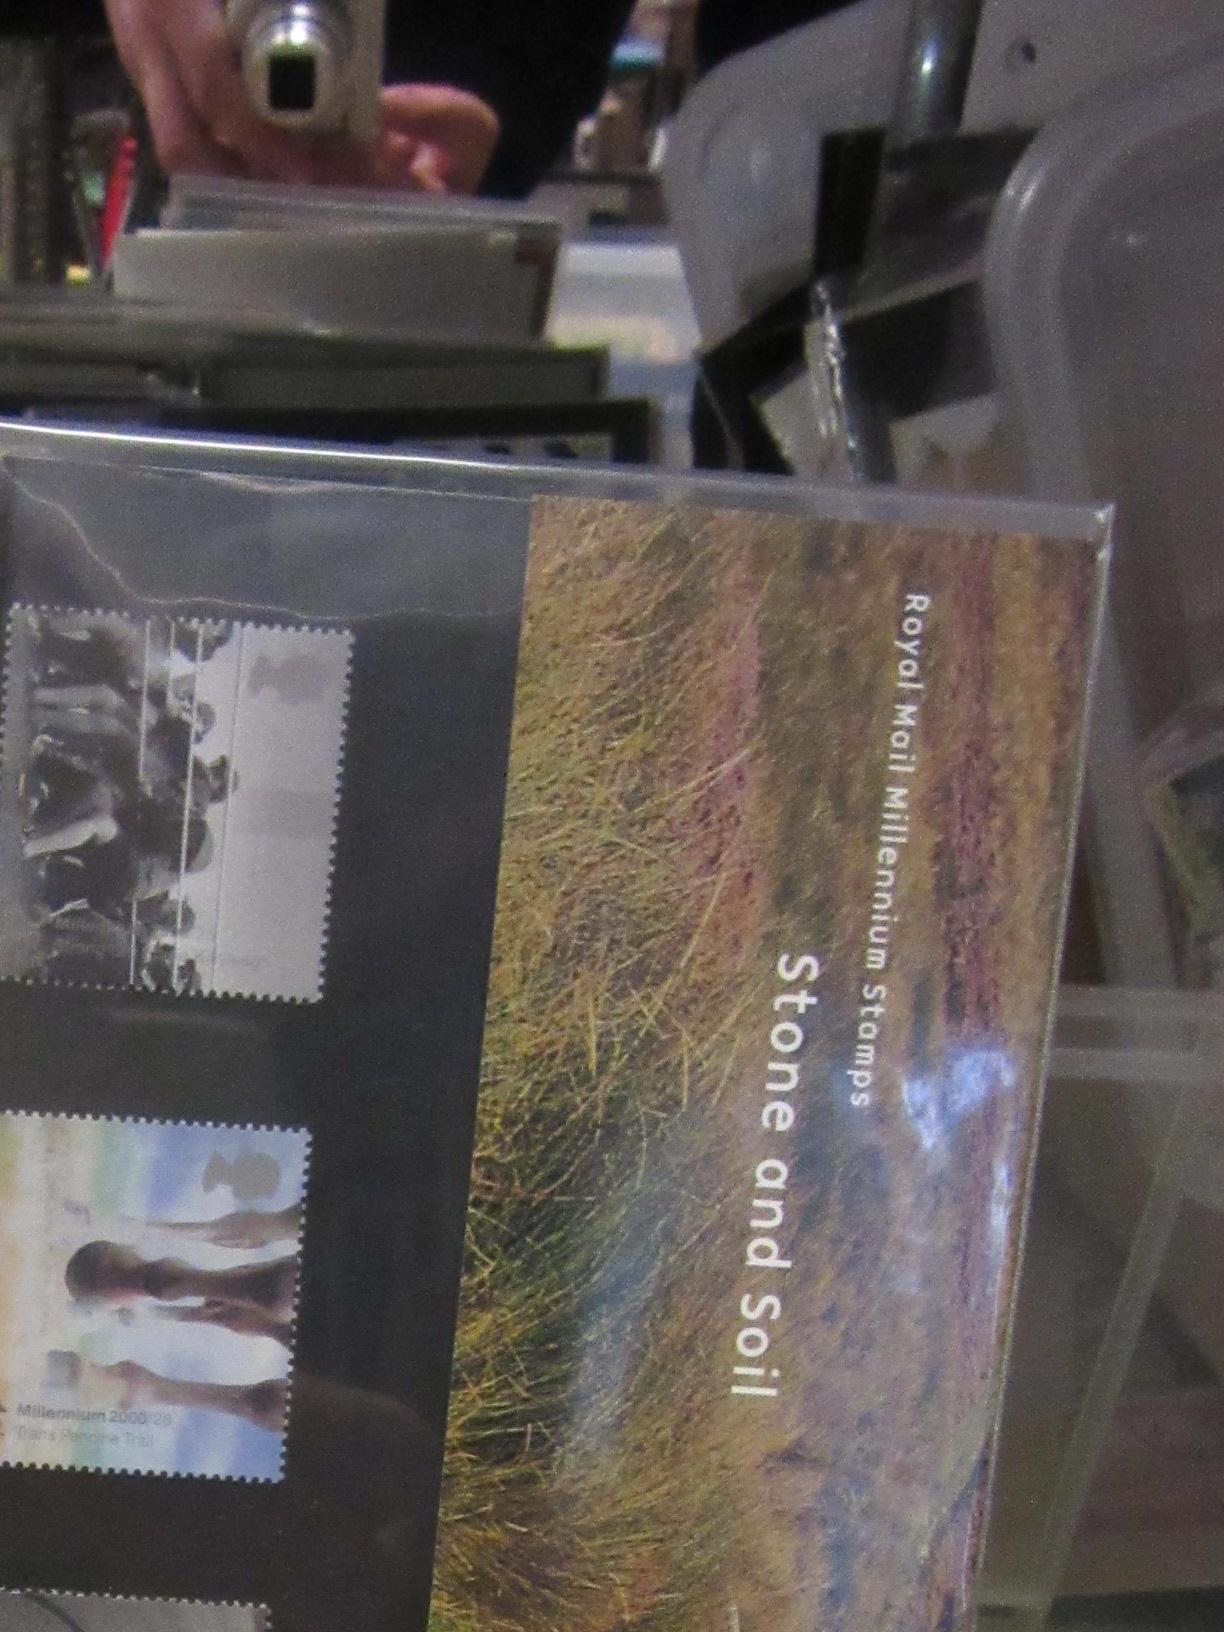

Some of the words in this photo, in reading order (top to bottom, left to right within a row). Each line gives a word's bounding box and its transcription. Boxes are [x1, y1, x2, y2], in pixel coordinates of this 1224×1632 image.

[894, 593, 932, 690] Royal
[887, 703, 919, 773] Mail
[865, 786, 910, 971] Millennium
[760, 952, 820, 1132] Stone
[846, 982, 887, 1107] Stamps
[744, 1158, 793, 1269] and
[730, 1292, 783, 1397] Soil
